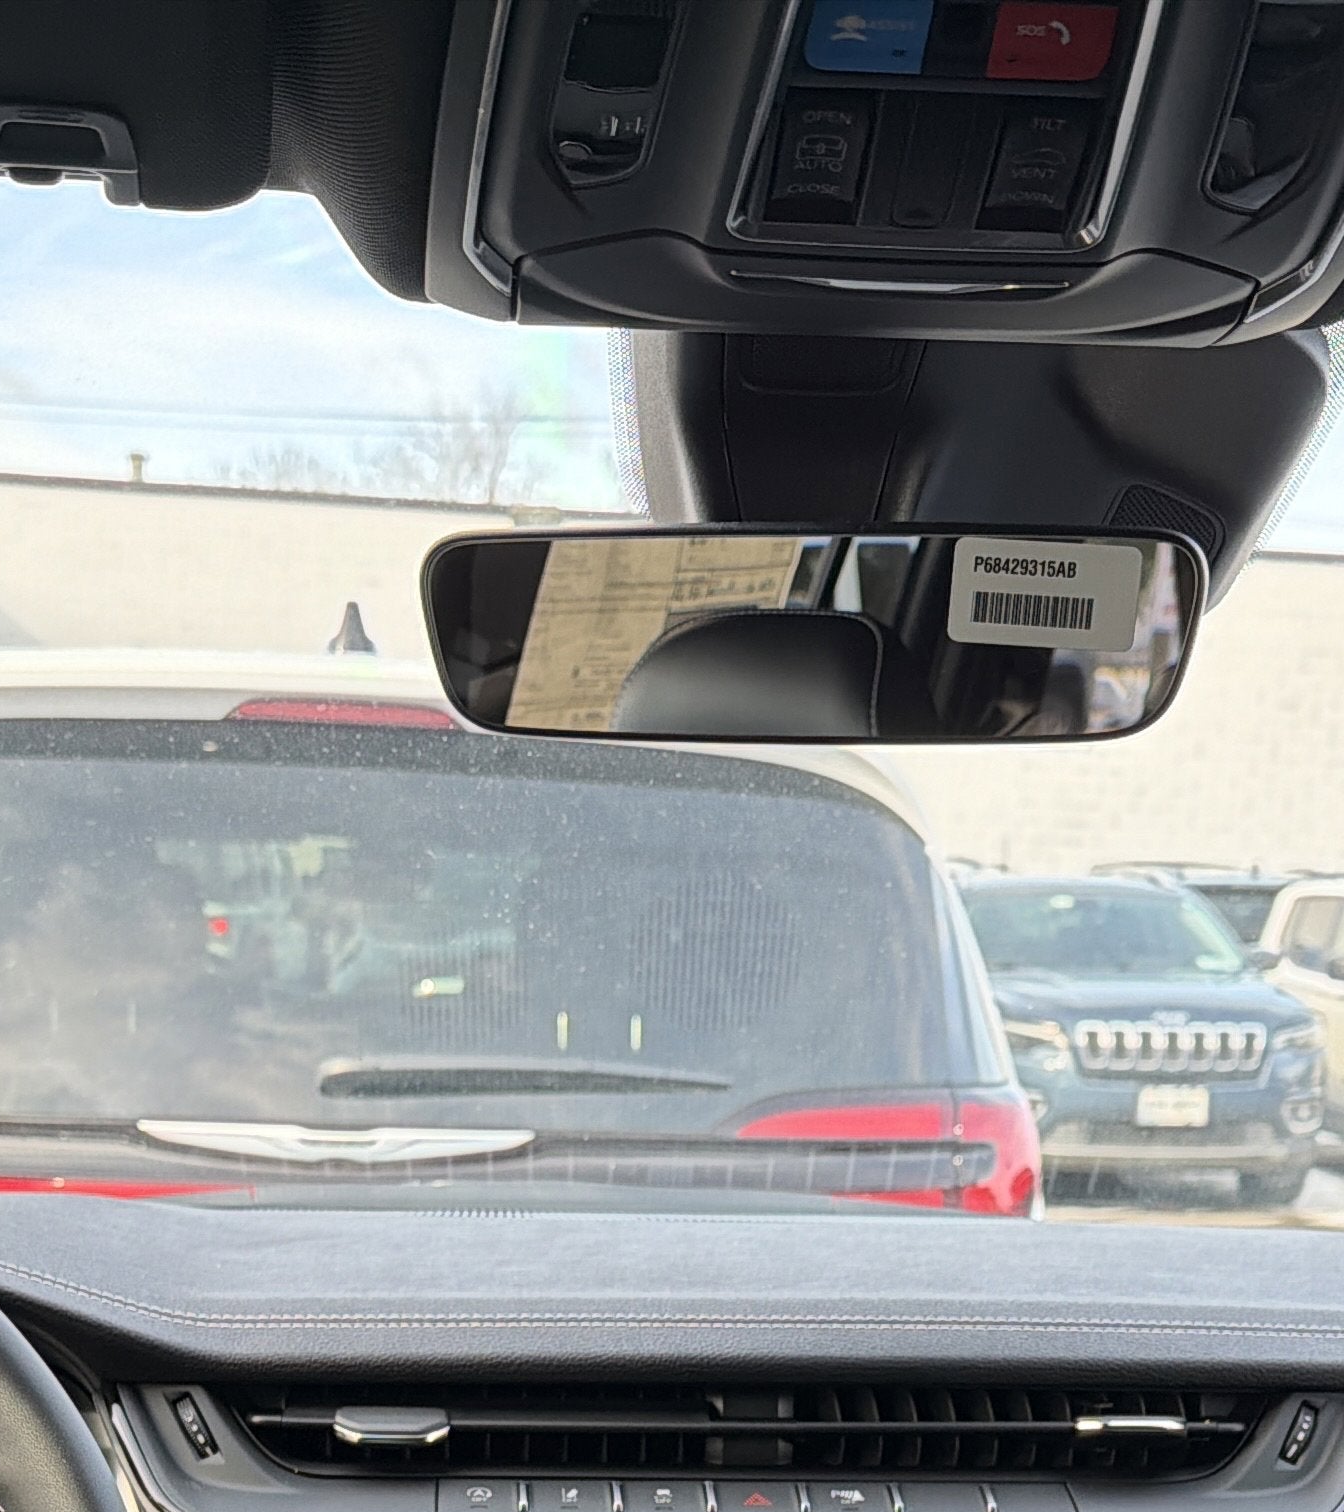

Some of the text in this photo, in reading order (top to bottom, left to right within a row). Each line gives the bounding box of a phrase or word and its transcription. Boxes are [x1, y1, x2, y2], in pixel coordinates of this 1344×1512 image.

[1016, 24, 1047, 37] SOS
[803, 110, 853, 125] OPEN
[793, 159, 843, 173] AUTO
[787, 182, 841, 195] CLOSE
[973, 555, 1078, 579] P68429315AB
